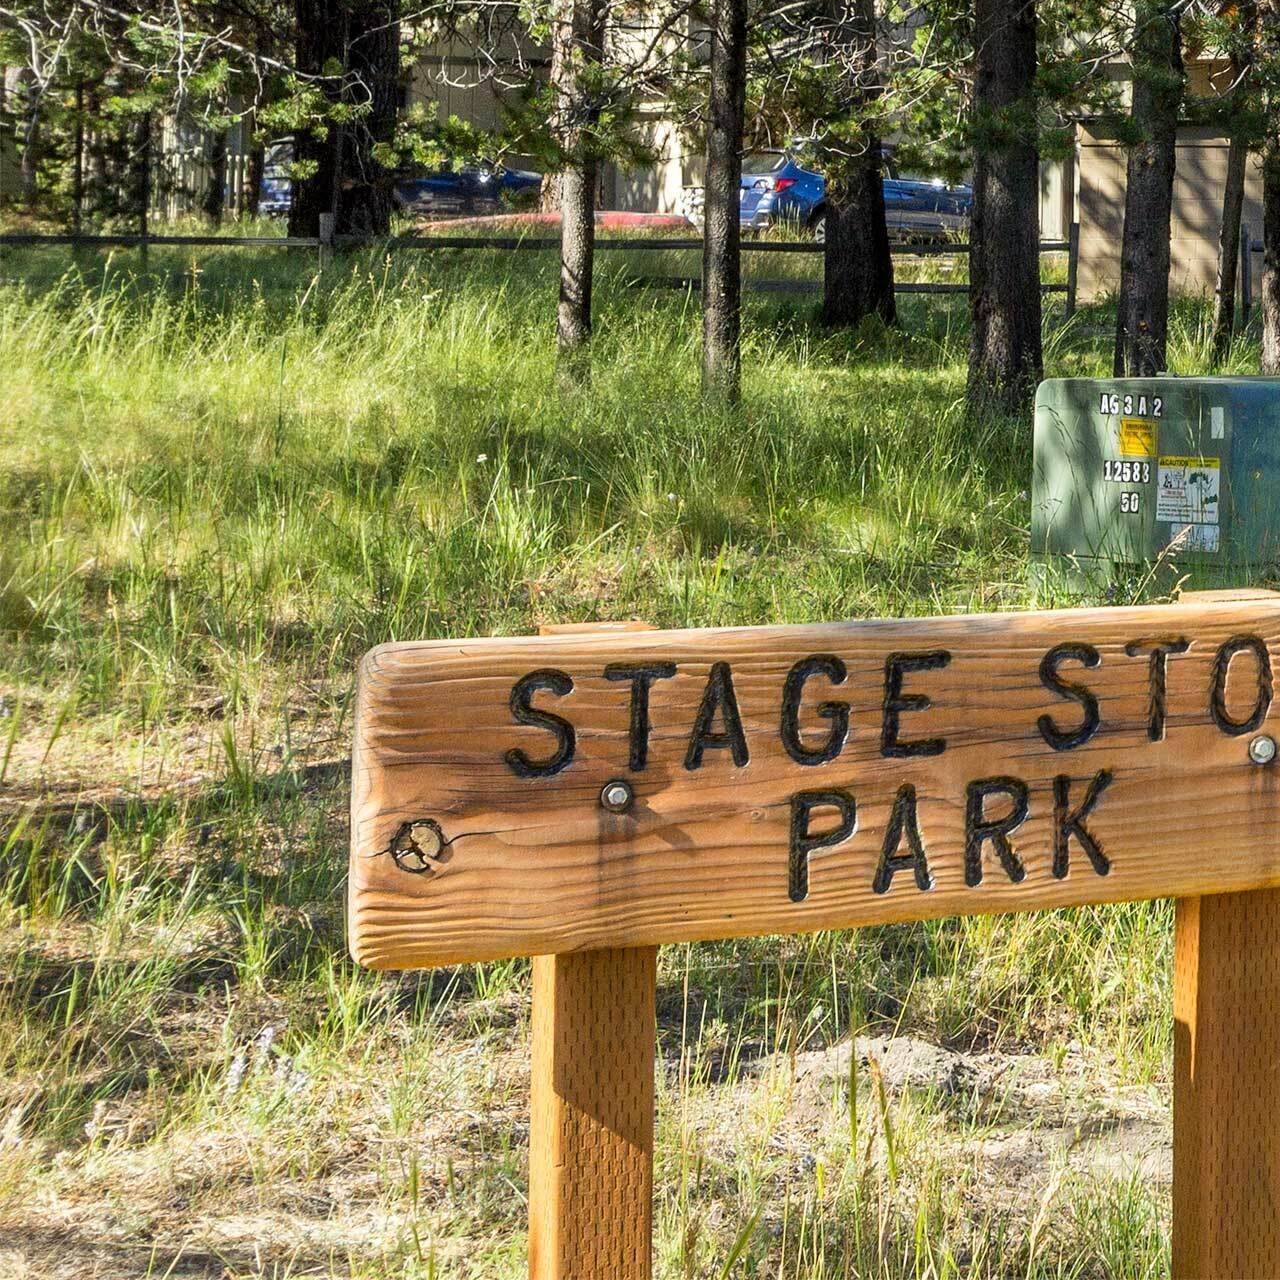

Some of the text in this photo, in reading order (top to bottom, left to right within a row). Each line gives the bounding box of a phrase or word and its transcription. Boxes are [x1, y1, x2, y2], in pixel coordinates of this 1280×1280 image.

[1120, 492, 1139, 513] 50
[504, 649, 953, 779] STAGE
[787, 767, 1113, 903] PARK
